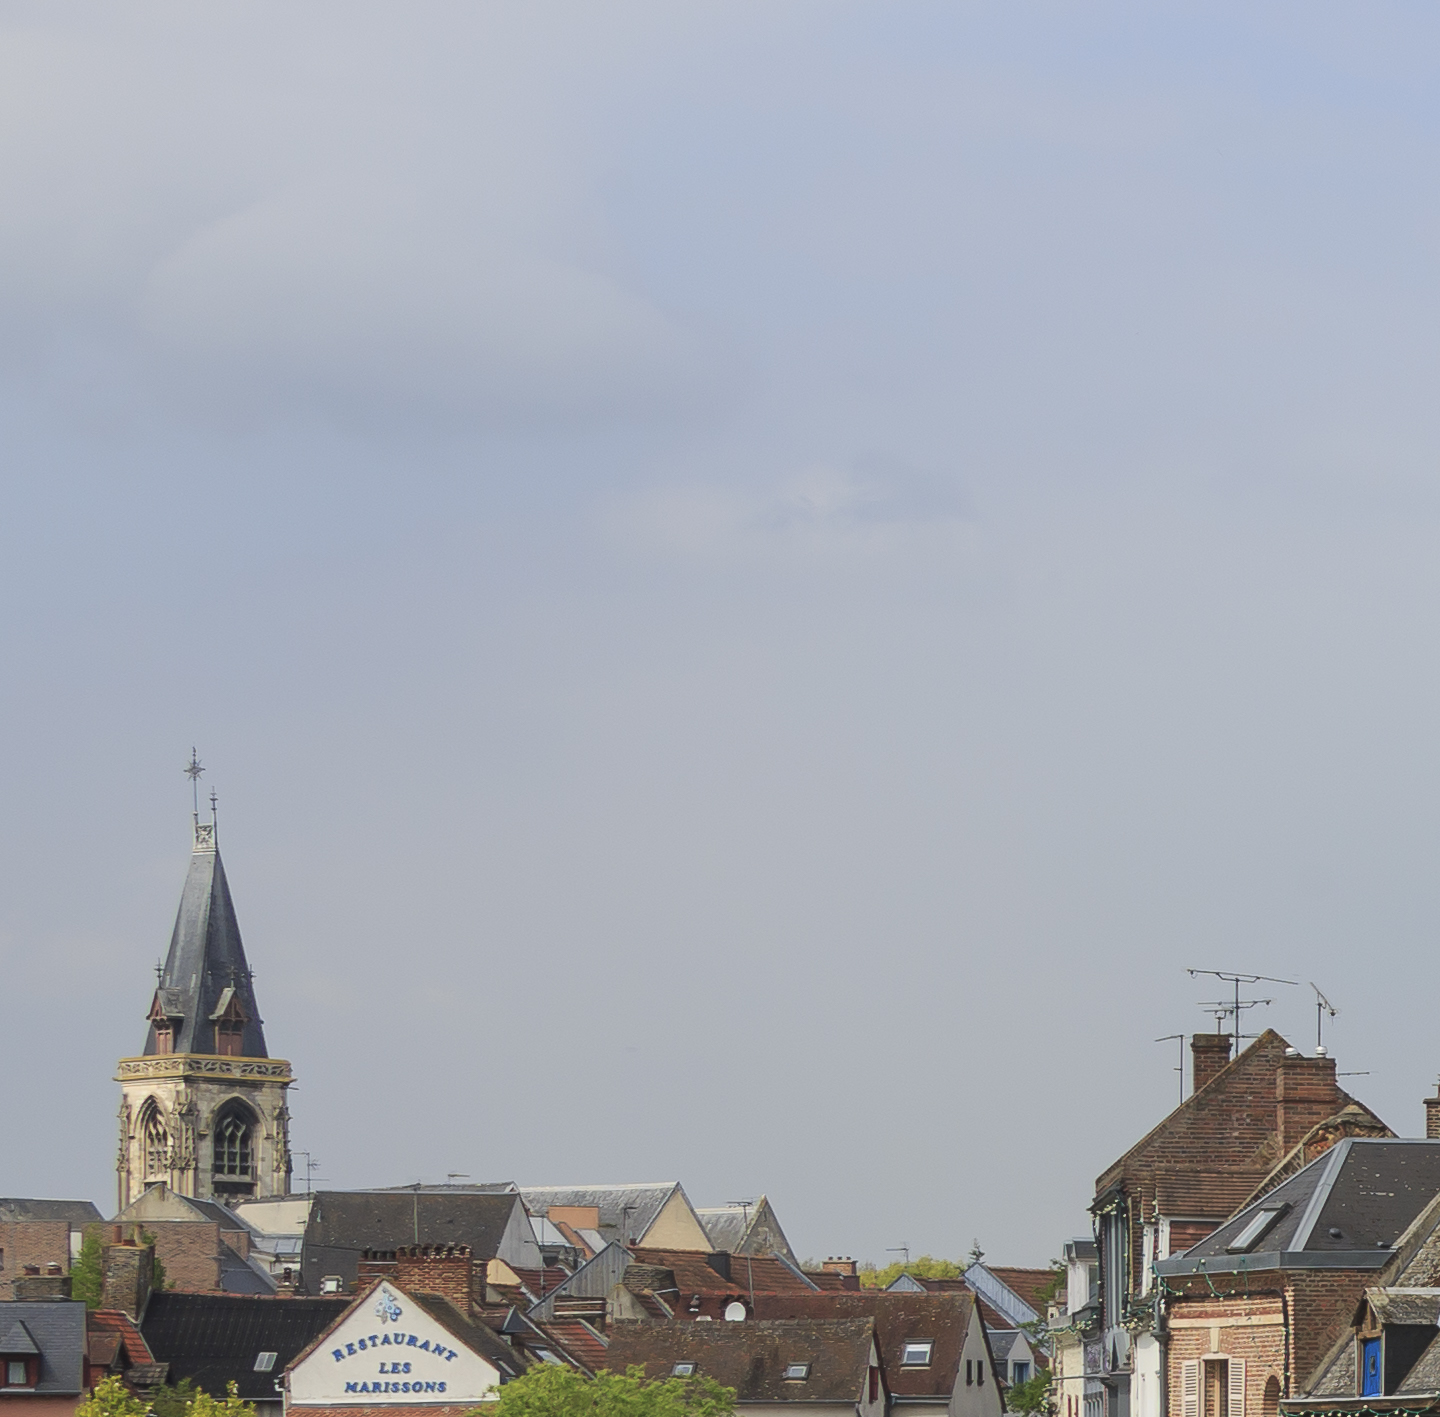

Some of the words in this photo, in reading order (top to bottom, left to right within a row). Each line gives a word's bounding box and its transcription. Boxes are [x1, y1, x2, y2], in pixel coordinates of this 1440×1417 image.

[331, 1332, 459, 1363] RESTAURANT
[378, 1361, 412, 1374] LES
[344, 1380, 447, 1393] MARISSONS
